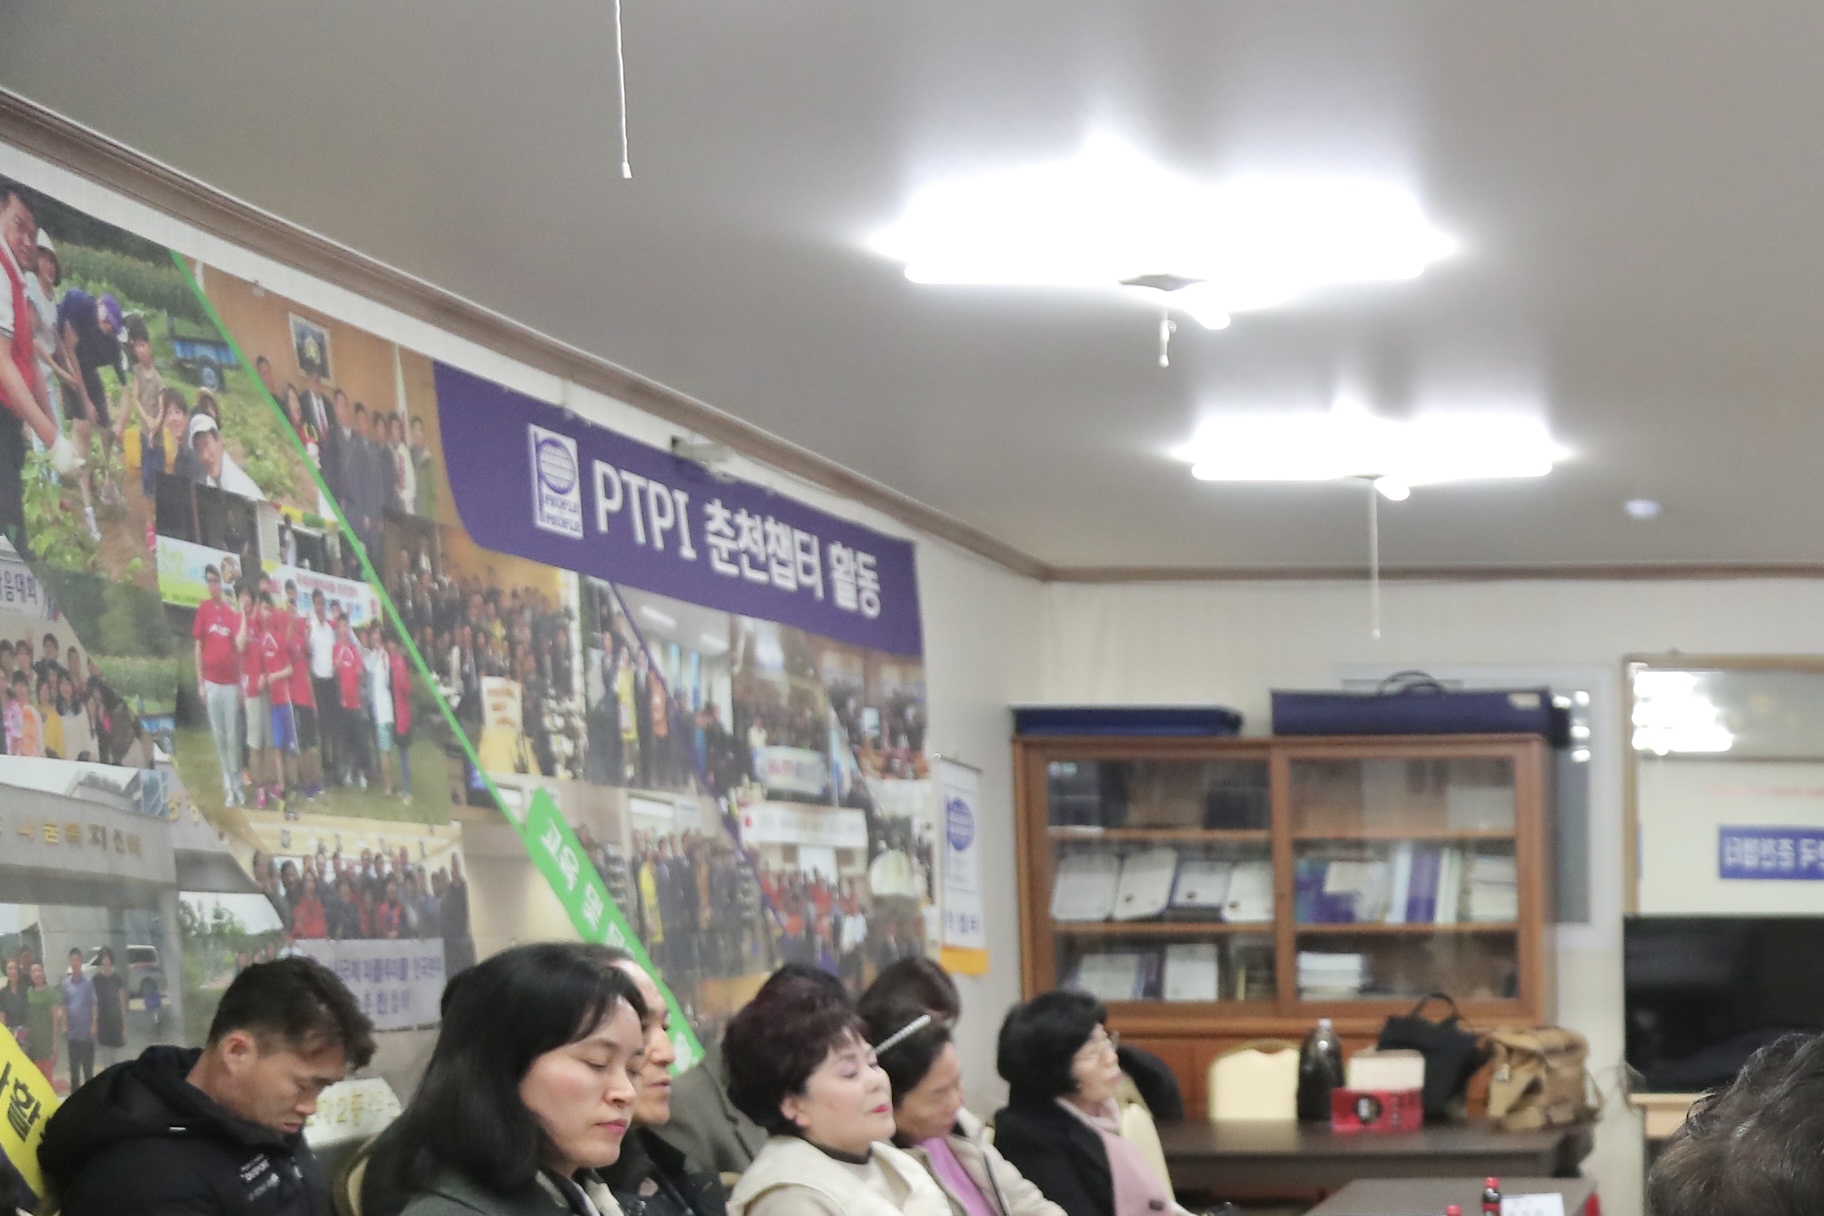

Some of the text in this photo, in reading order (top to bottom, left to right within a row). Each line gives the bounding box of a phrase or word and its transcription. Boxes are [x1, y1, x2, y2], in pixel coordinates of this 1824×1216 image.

[593, 458, 881, 619] PTPI 춘천챕터 활동
[0, 571, 38, 605] 음대회
